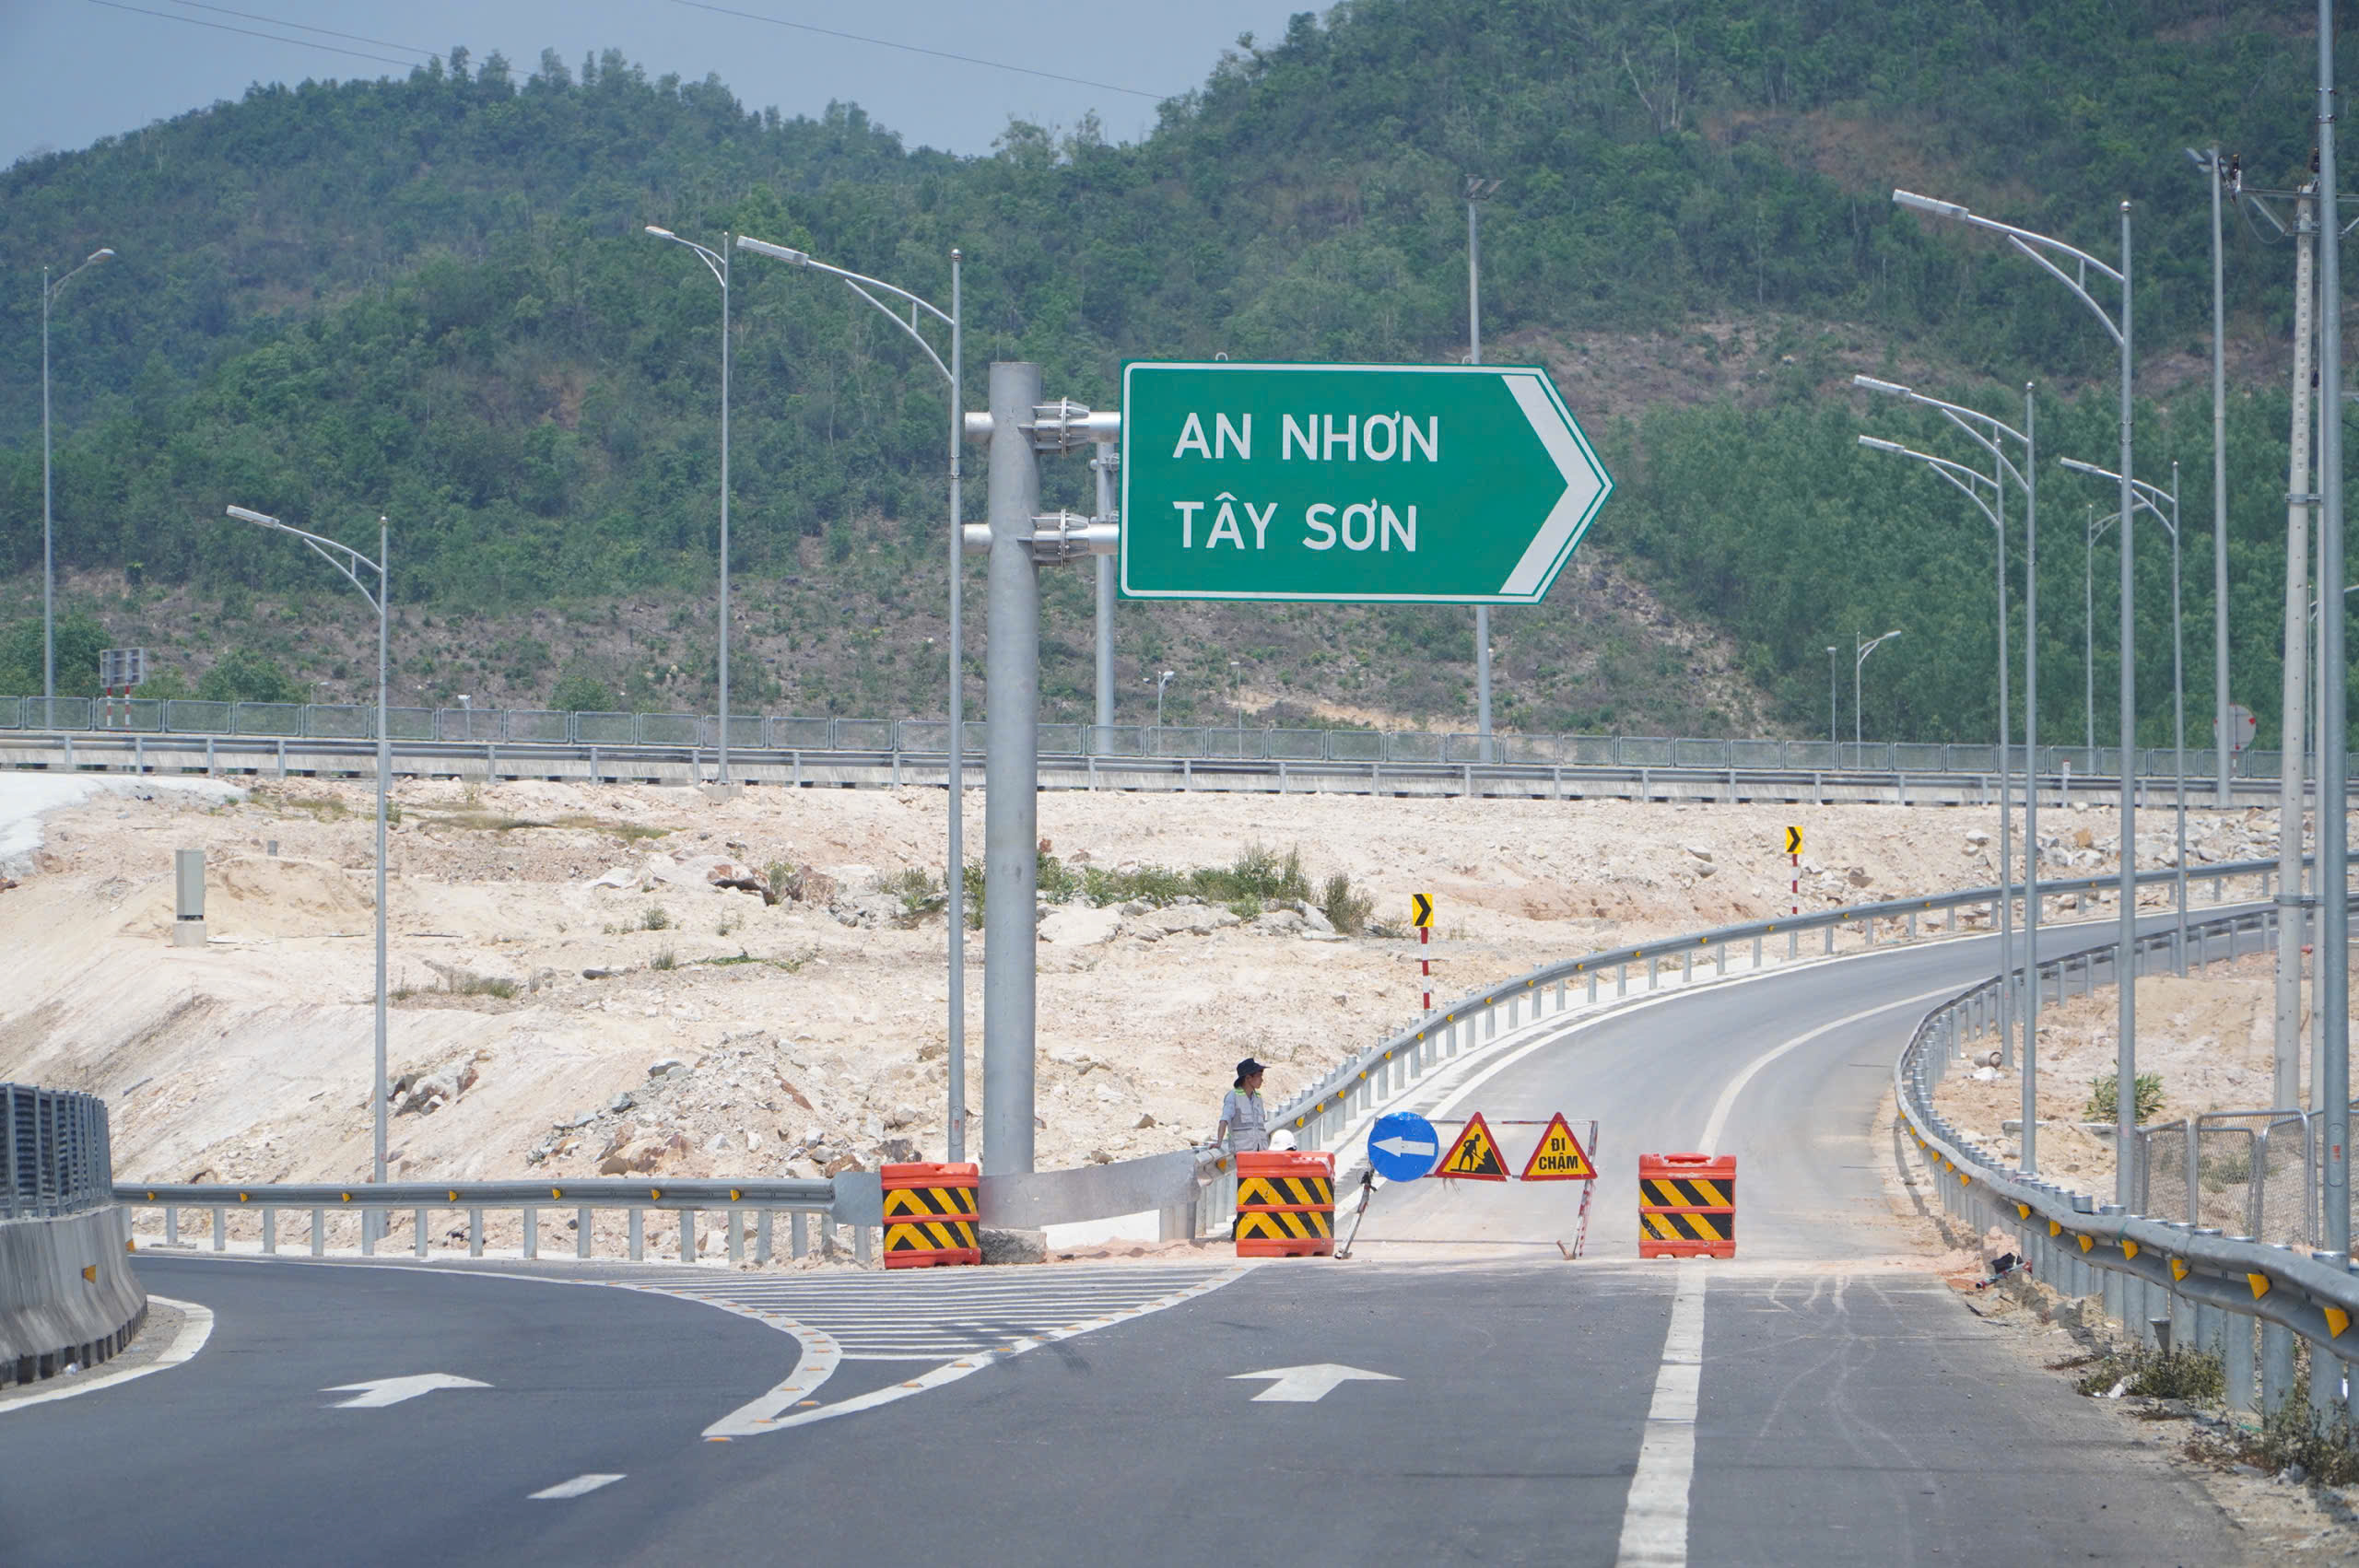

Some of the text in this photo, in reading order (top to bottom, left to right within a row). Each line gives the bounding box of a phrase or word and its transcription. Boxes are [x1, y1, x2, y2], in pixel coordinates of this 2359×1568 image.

[1172, 411, 1438, 462] AN NHƠN
[1173, 492, 1417, 553] TÂY SƠN
[1538, 1152, 1579, 1173] CHẬM
[1551, 1138, 1566, 1152] ĐI
